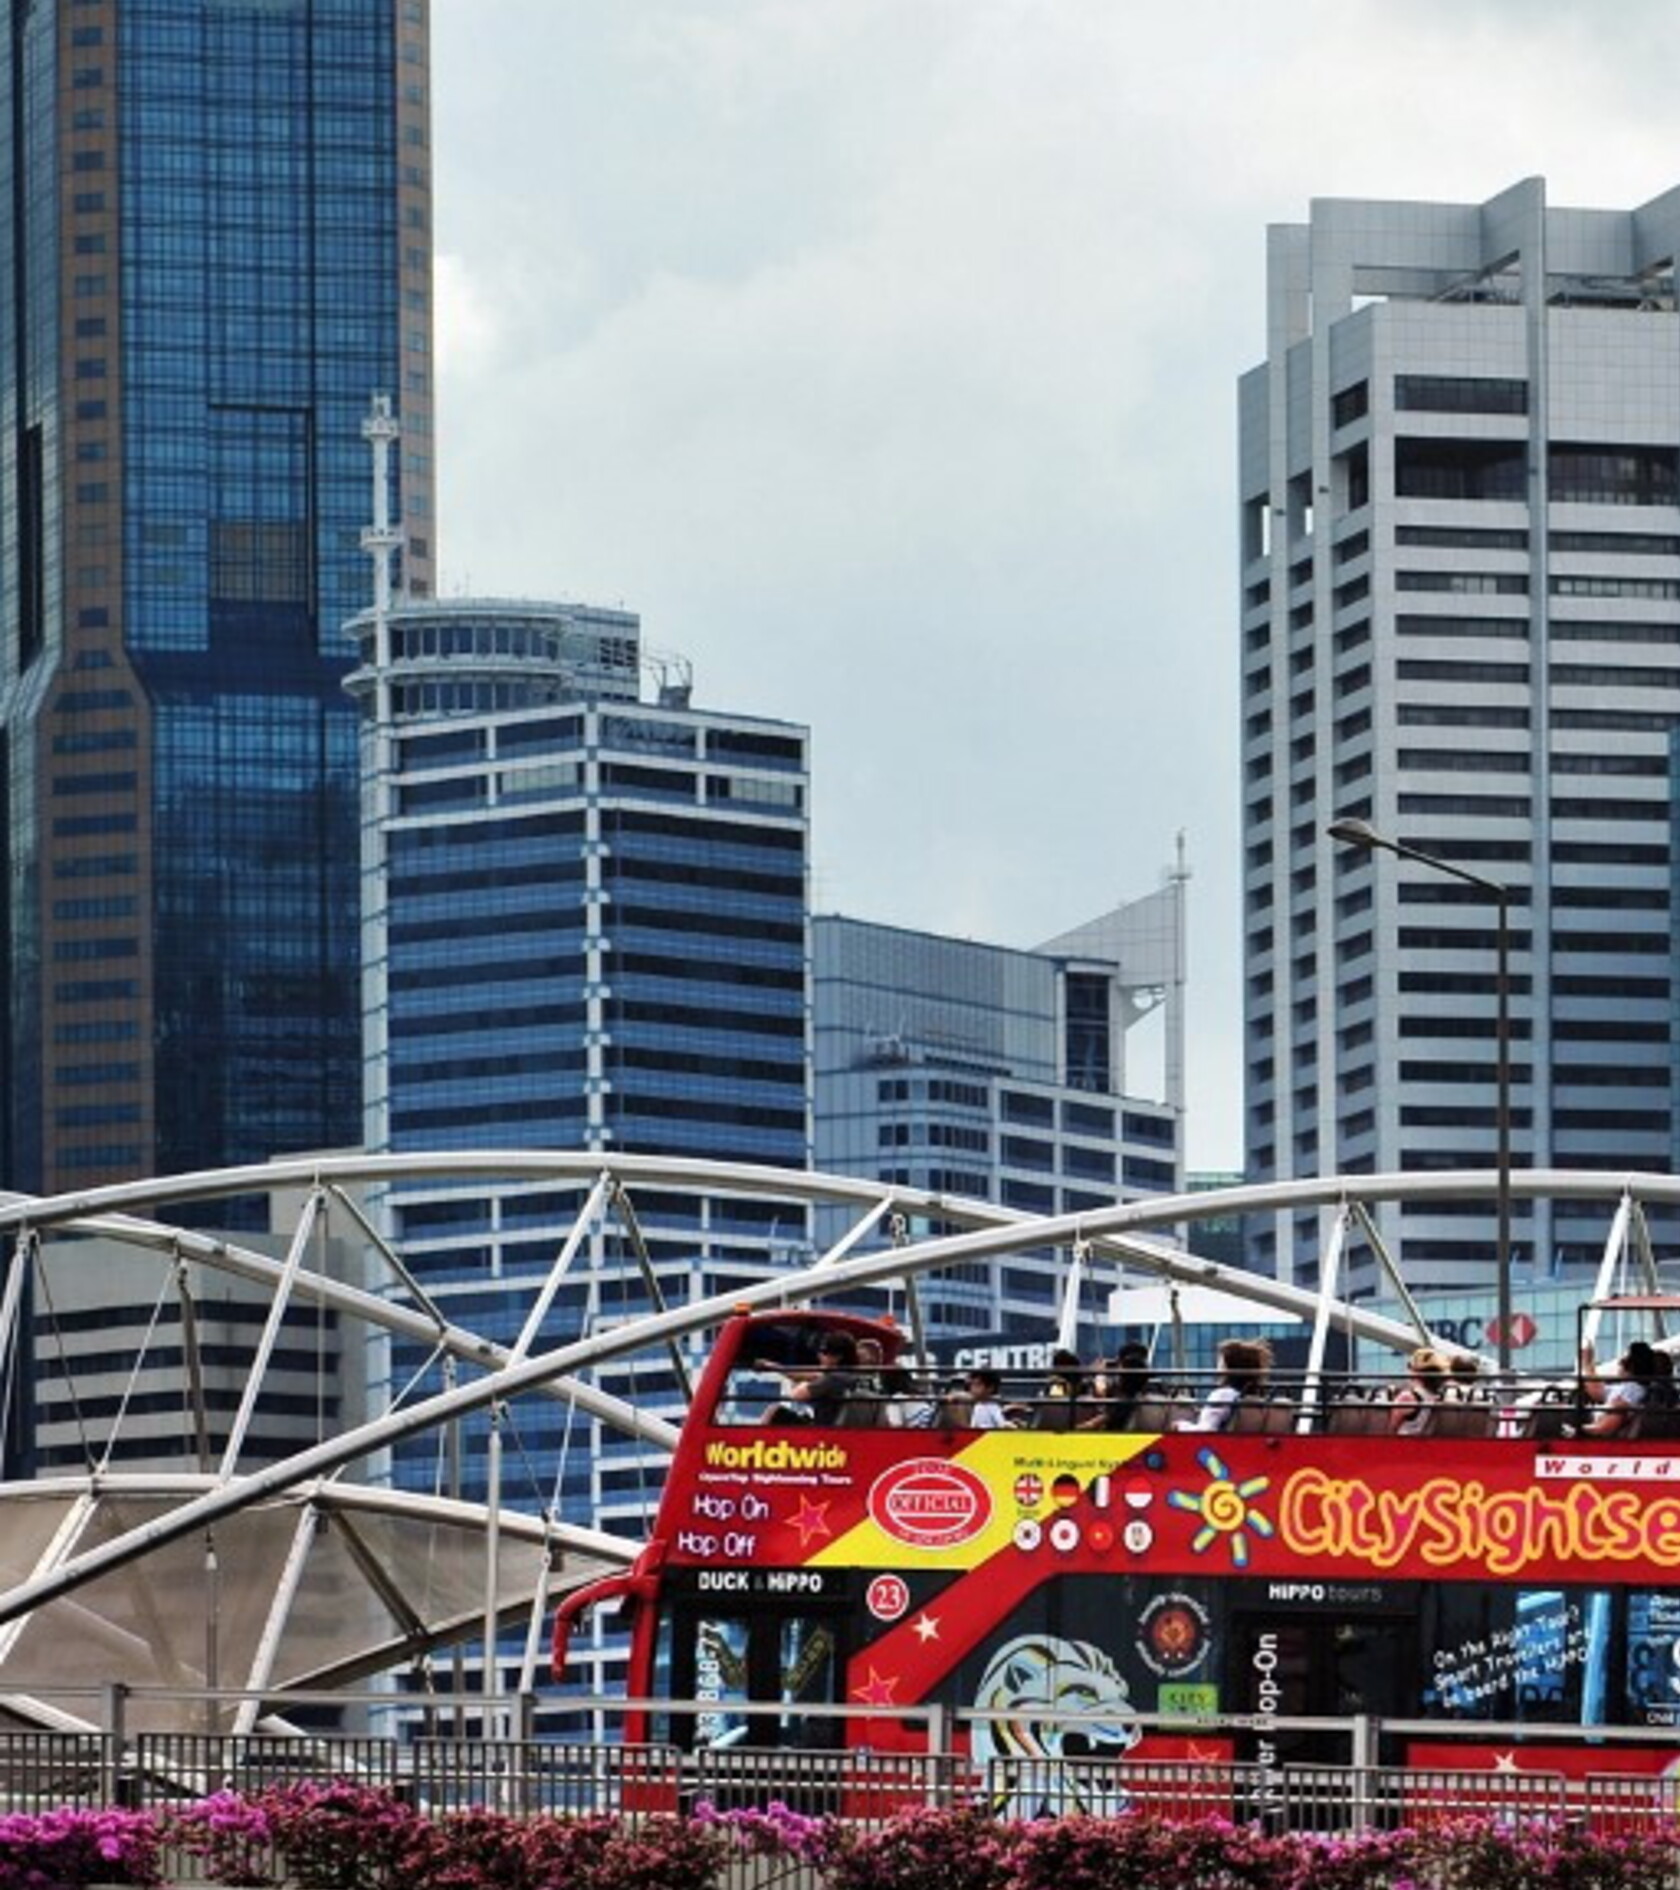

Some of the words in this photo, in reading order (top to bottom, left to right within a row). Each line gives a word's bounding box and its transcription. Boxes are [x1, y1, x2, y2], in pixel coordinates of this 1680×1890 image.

[821, 1474, 852, 1486] Tours
[693, 1494, 736, 1520] Hop
[741, 1493, 769, 1520] On
[891, 1494, 970, 1512] OFFICIAL
[678, 1531, 719, 1557] Hop
[724, 1531, 757, 1557] Off
[698, 1571, 749, 1591] DUCK
[875, 1583, 901, 1610] 23
[1433, 1649, 1457, 1669] On
